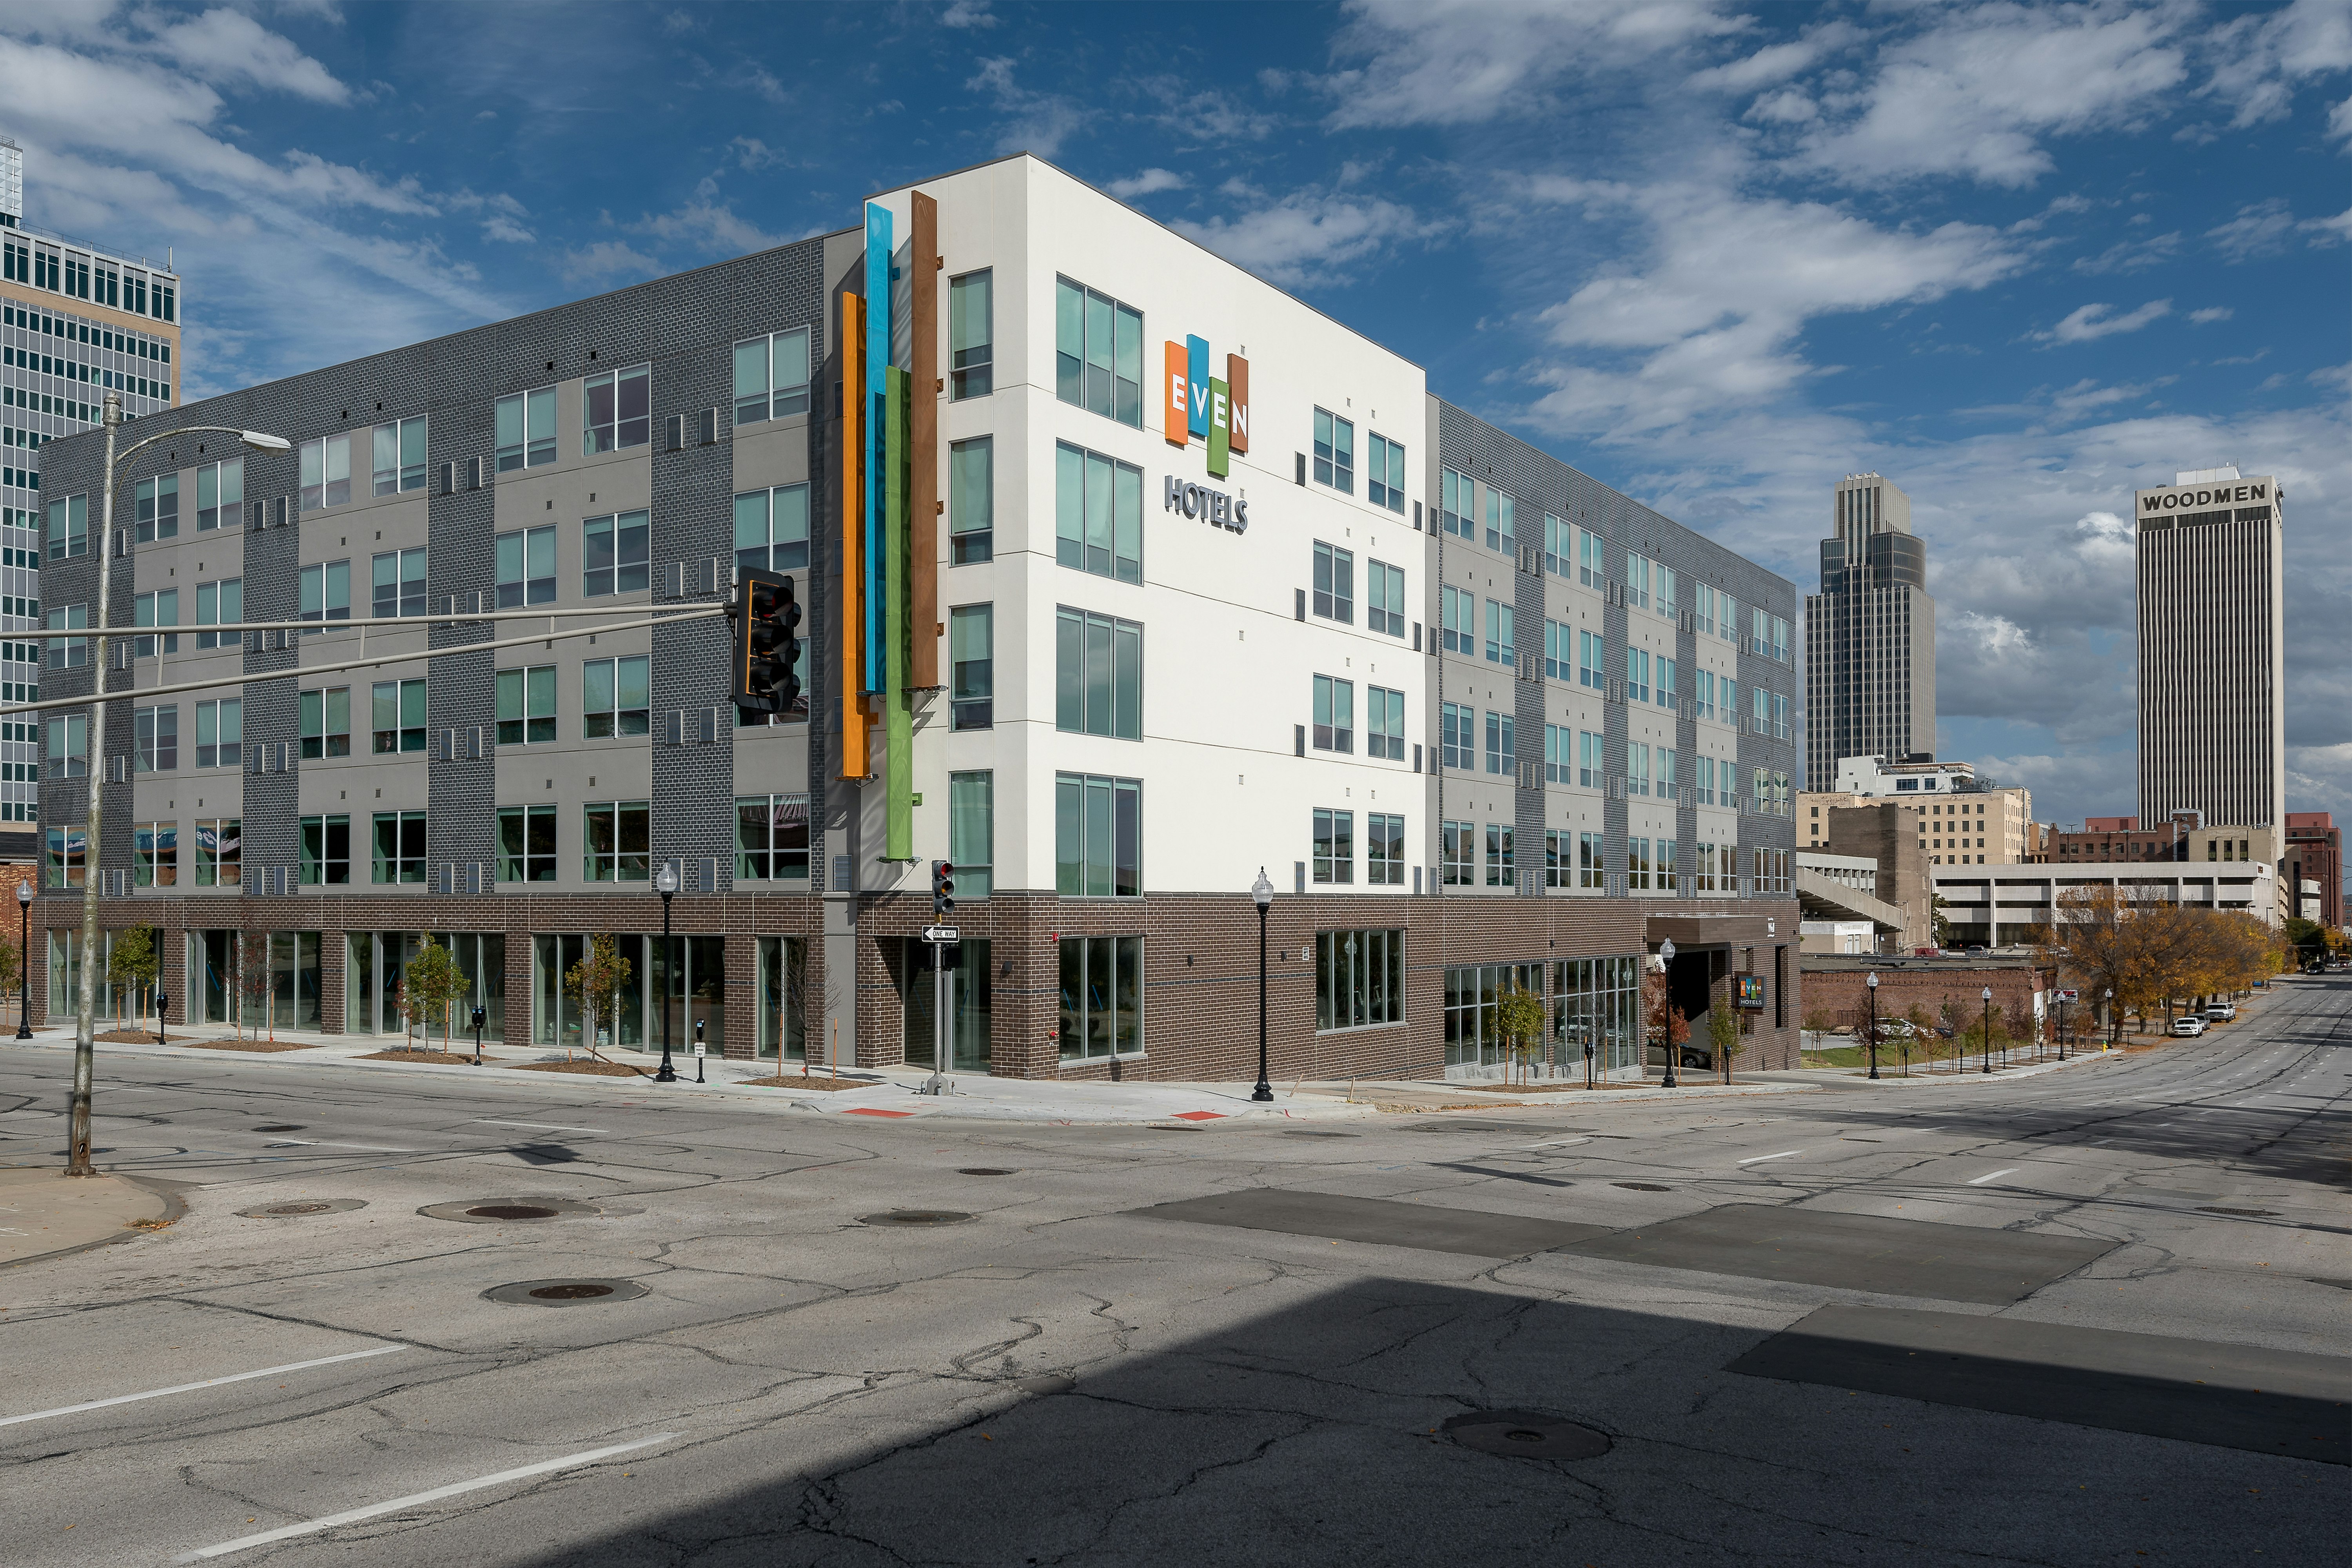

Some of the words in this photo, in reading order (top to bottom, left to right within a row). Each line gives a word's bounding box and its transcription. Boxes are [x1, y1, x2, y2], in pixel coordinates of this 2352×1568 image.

[1172, 373, 1247, 438] EVEN
[1165, 475, 1248, 533] HOTELS
[2143, 484, 2265, 511] WOODMEN
